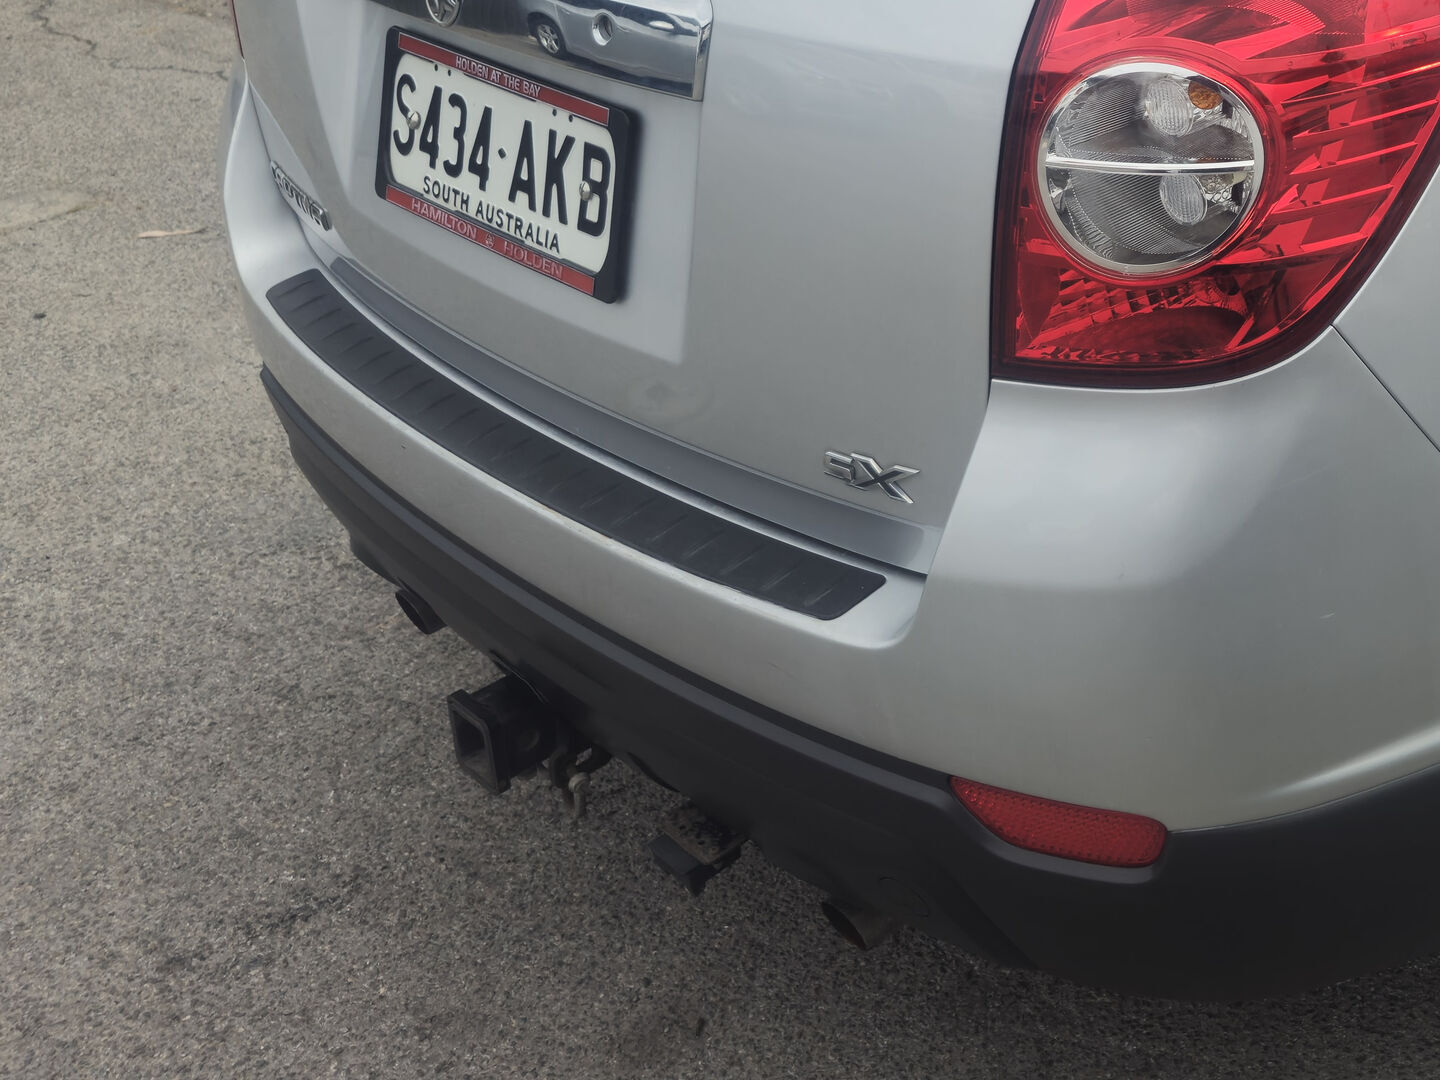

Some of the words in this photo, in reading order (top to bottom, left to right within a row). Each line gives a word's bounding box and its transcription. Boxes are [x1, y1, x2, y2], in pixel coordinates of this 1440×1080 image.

[455, 56, 489, 80] HOLDEN
[491, 66, 502, 82] AT
[503, 73, 520, 90] THE
[521, 79, 541, 97] BAY
[411, 198, 477, 240] HAMILTON
[503, 241, 563, 278] HOLDEN
[423, 176, 470, 212] SOUTH
[475, 200, 560, 254] AUSTRALIA
[823, 451, 921, 505] SX
